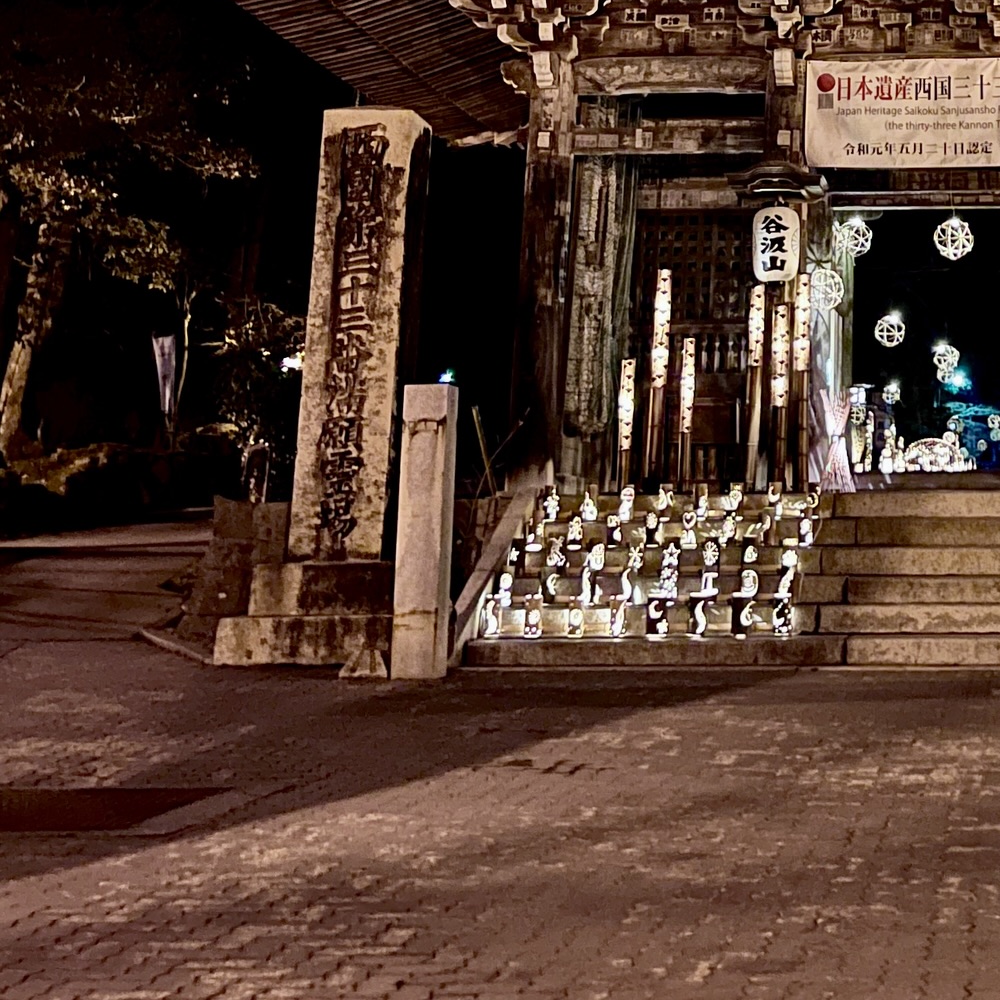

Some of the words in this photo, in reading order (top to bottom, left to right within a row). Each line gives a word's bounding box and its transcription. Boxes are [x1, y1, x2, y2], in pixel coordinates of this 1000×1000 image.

[836, 106, 862, 117] Japan
[864, 106, 903, 117] Heritage
[904, 105, 939, 115] Saikoku
[940, 105, 997, 117] Sanjusansho
[884, 120, 903, 131] (the
[905, 120, 957, 132] thirty-three
[959, 120, 994, 130] Kannon
[843, 141, 993, 156] 令和元年五月二十日認定
[760, 214, 790, 272] 谷汲山
